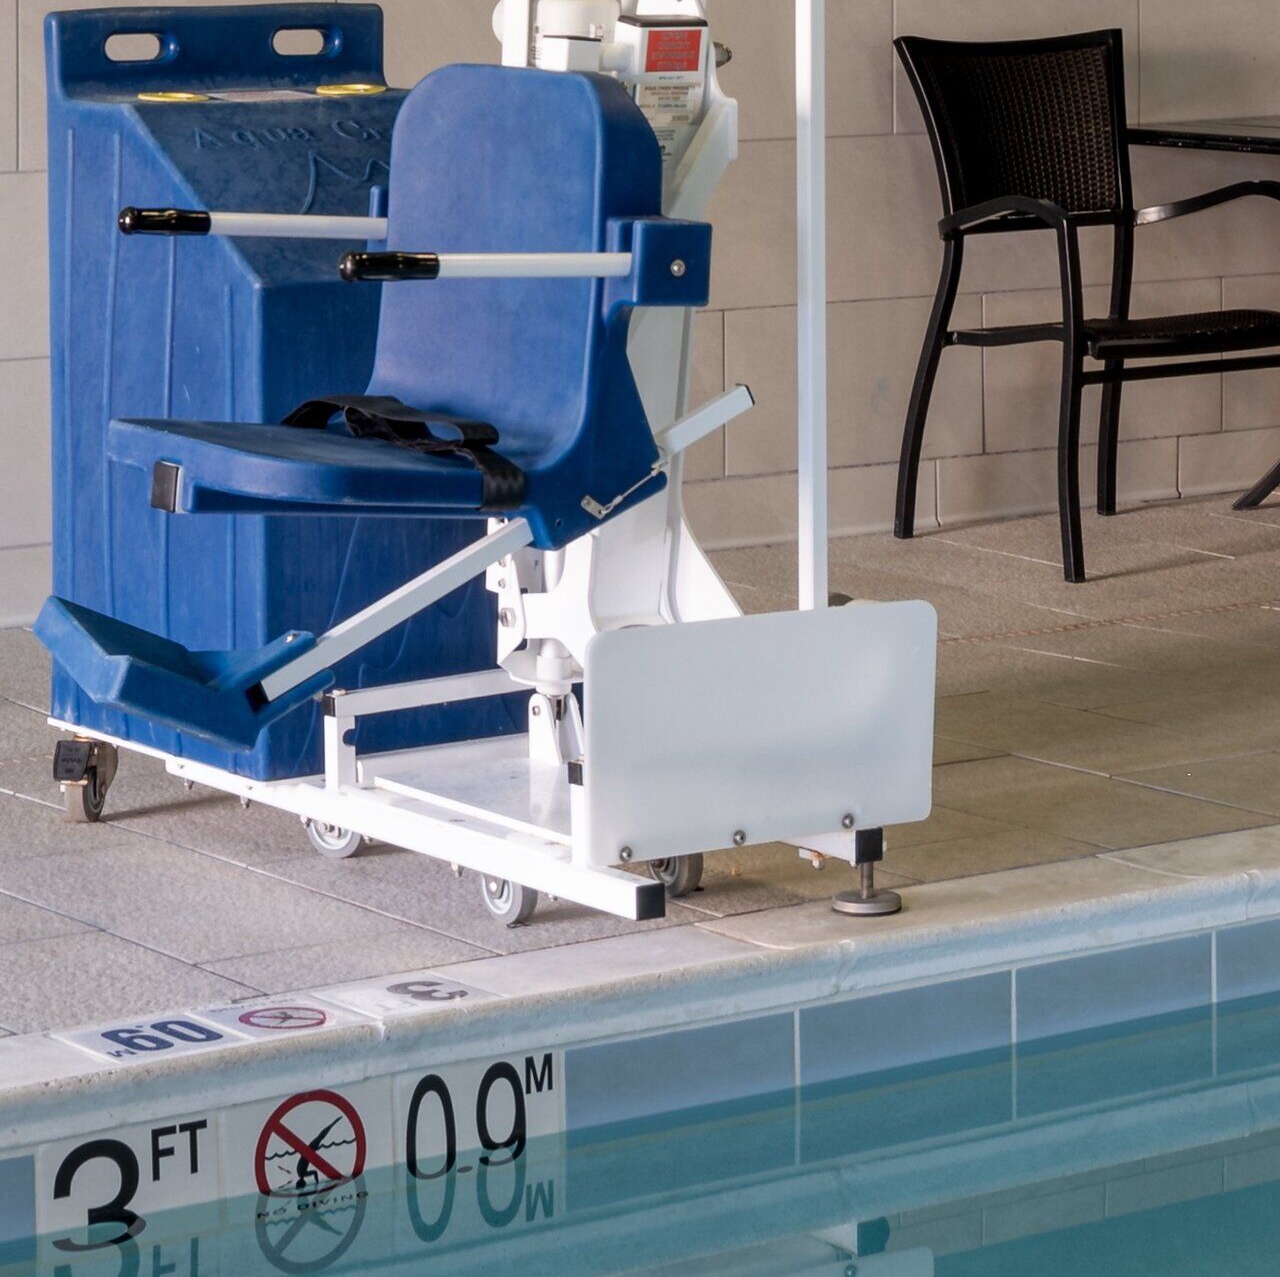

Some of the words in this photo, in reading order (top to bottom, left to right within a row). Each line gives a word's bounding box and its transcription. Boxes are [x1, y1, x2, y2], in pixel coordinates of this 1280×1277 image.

[193, 125, 317, 153] Aqua
[525, 1052, 553, 1095] M
[52, 1138, 147, 1252] 3
[151, 1118, 207, 1182] FT
[256, 1204, 287, 1220] NO
[297, 1190, 368, 1212] DIVING
